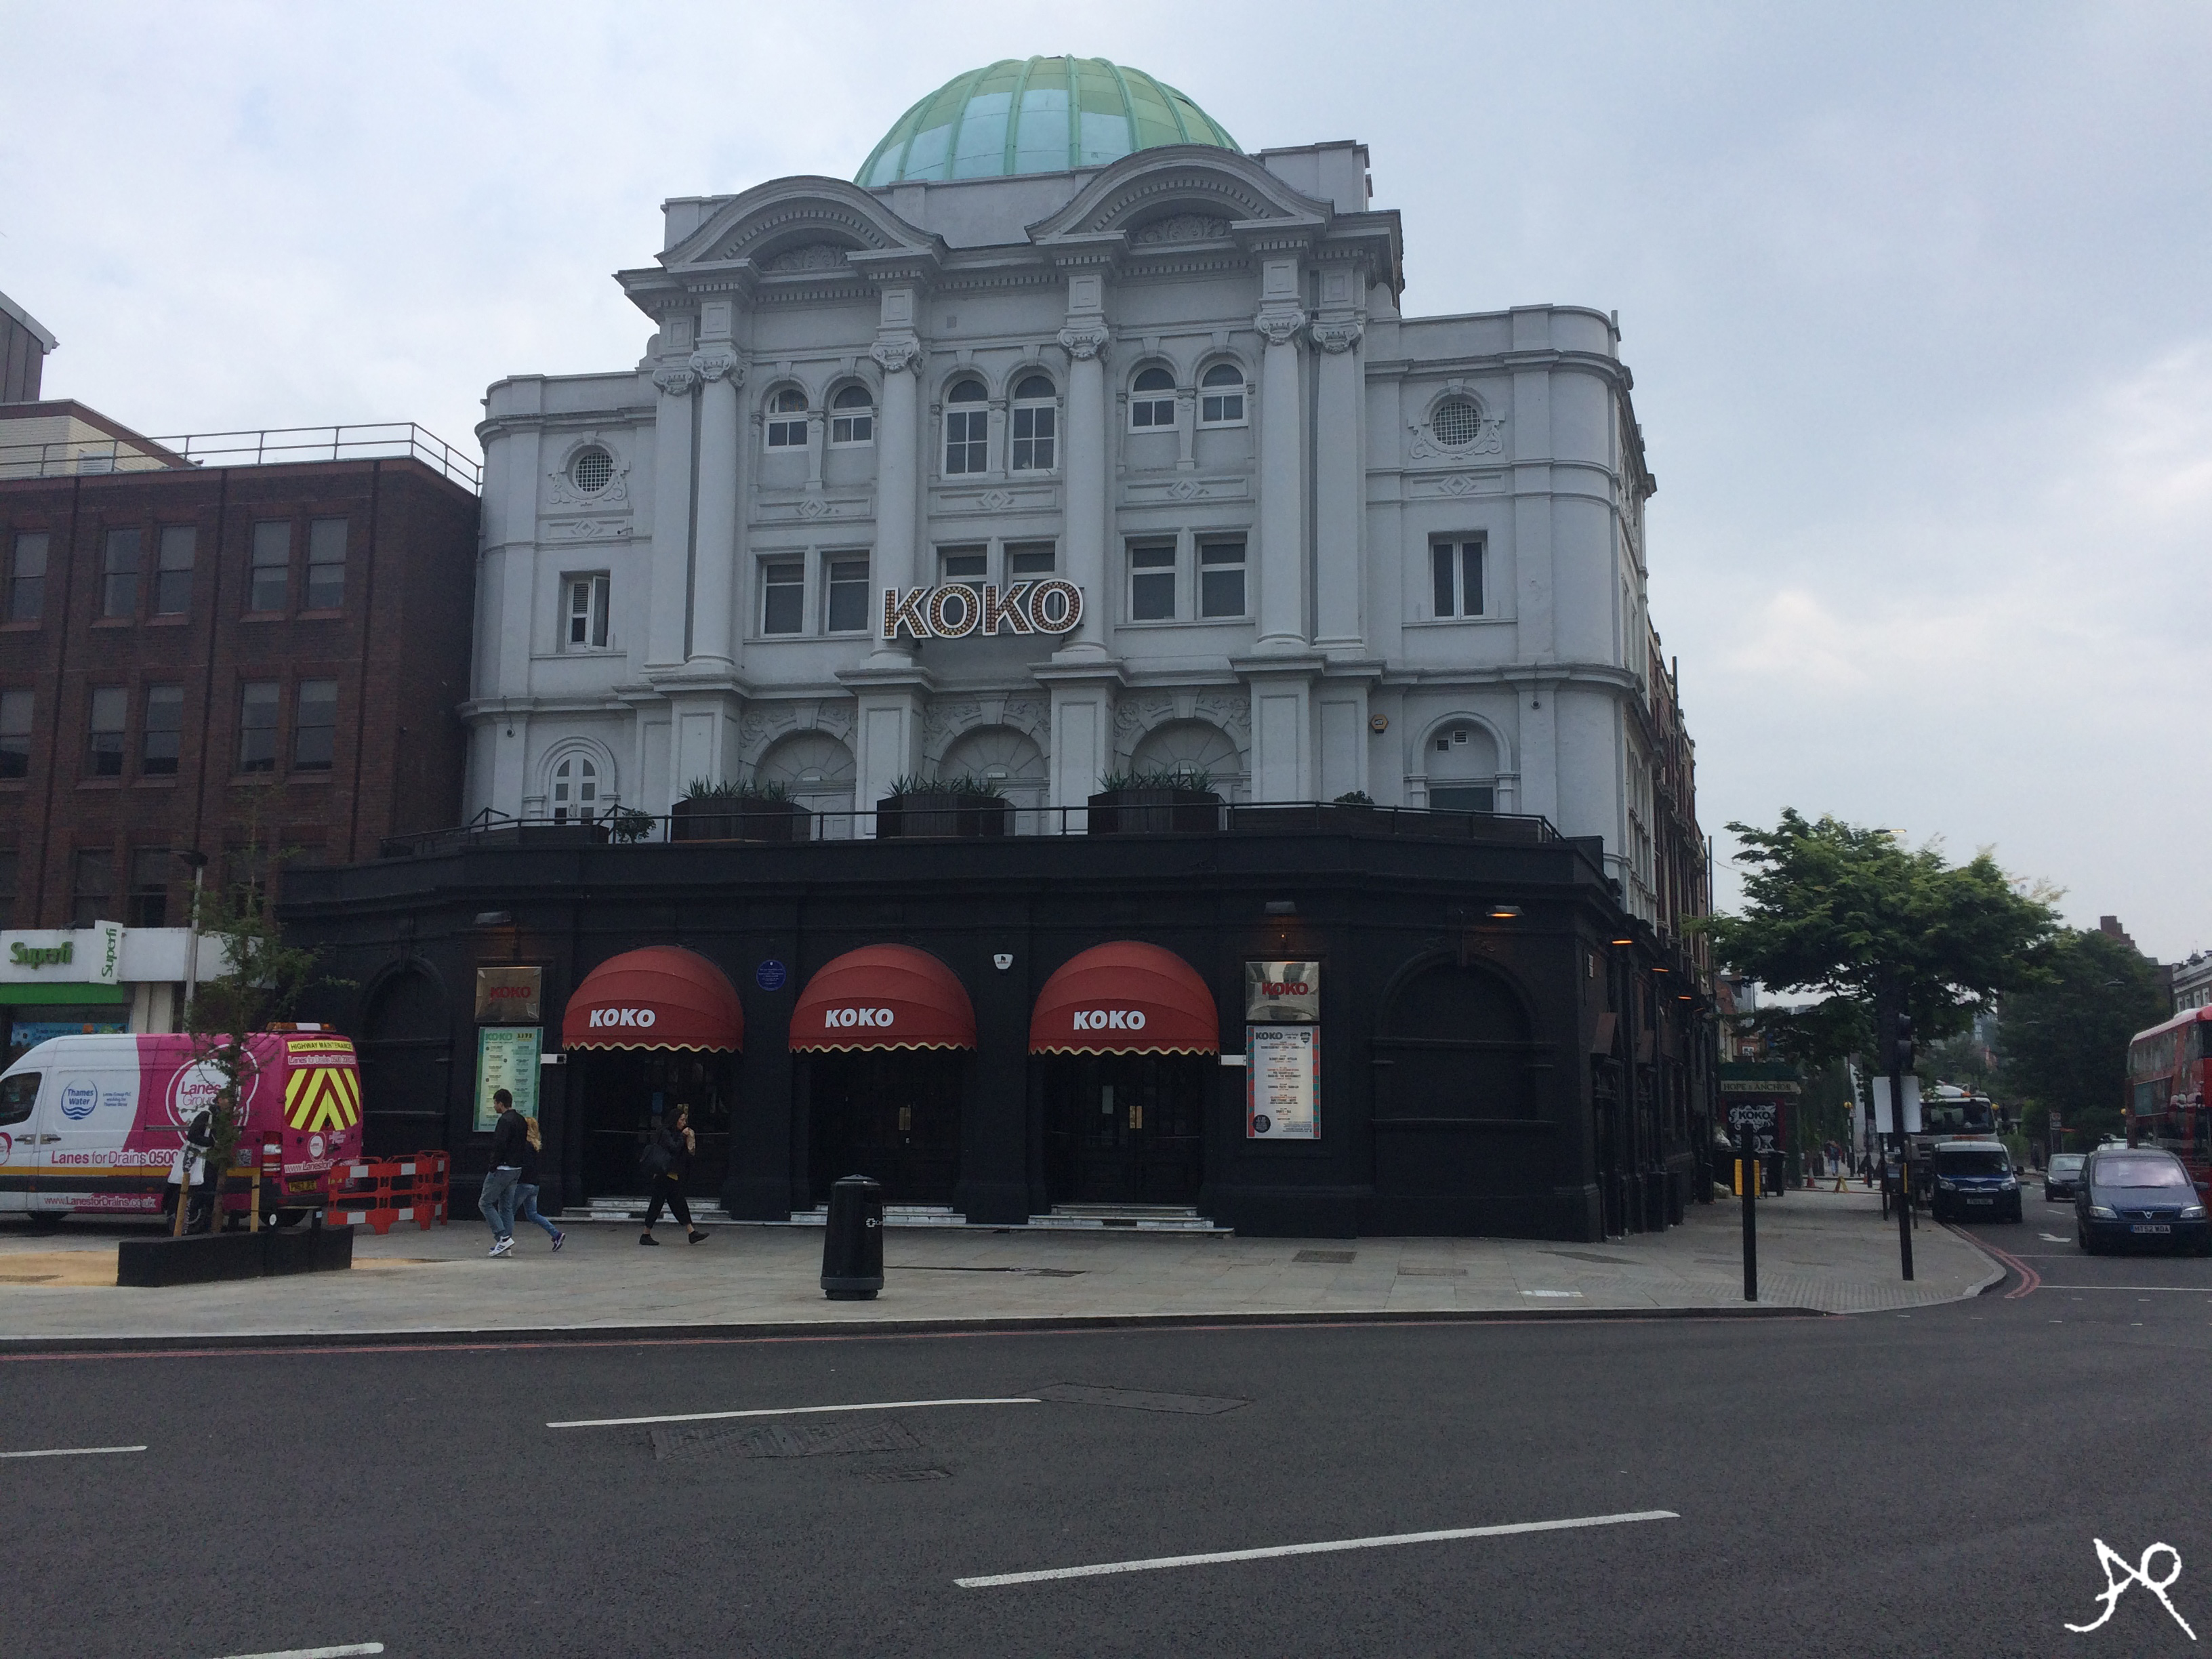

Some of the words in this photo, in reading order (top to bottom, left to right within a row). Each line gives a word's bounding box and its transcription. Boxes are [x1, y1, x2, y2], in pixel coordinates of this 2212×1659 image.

[882, 578, 1084, 639] KOKO
[9, 941, 73, 969] Superfi
[102, 928, 117, 977] Superfi
[490, 986, 532, 998] KOKO
[1262, 982, 1309, 996] KOKO
[590, 1008, 655, 1027] KOKO
[825, 1008, 894, 1028] KOKO
[1073, 1010, 1146, 1030] KOKO
[485, 1033, 513, 1041] KOKO
[1255, 1032, 1284, 1040] KOKO
[291, 1042, 318, 1050] HIGHWAY
[289, 1056, 307, 1064] Lanes
[68, 1088, 94, 1097] Thames
[1739, 1111, 1770, 1120] KOKO
[51, 1150, 89, 1164] Lanes
[91, 1150, 106, 1164] for
[108, 1150, 146, 1164] Drains
